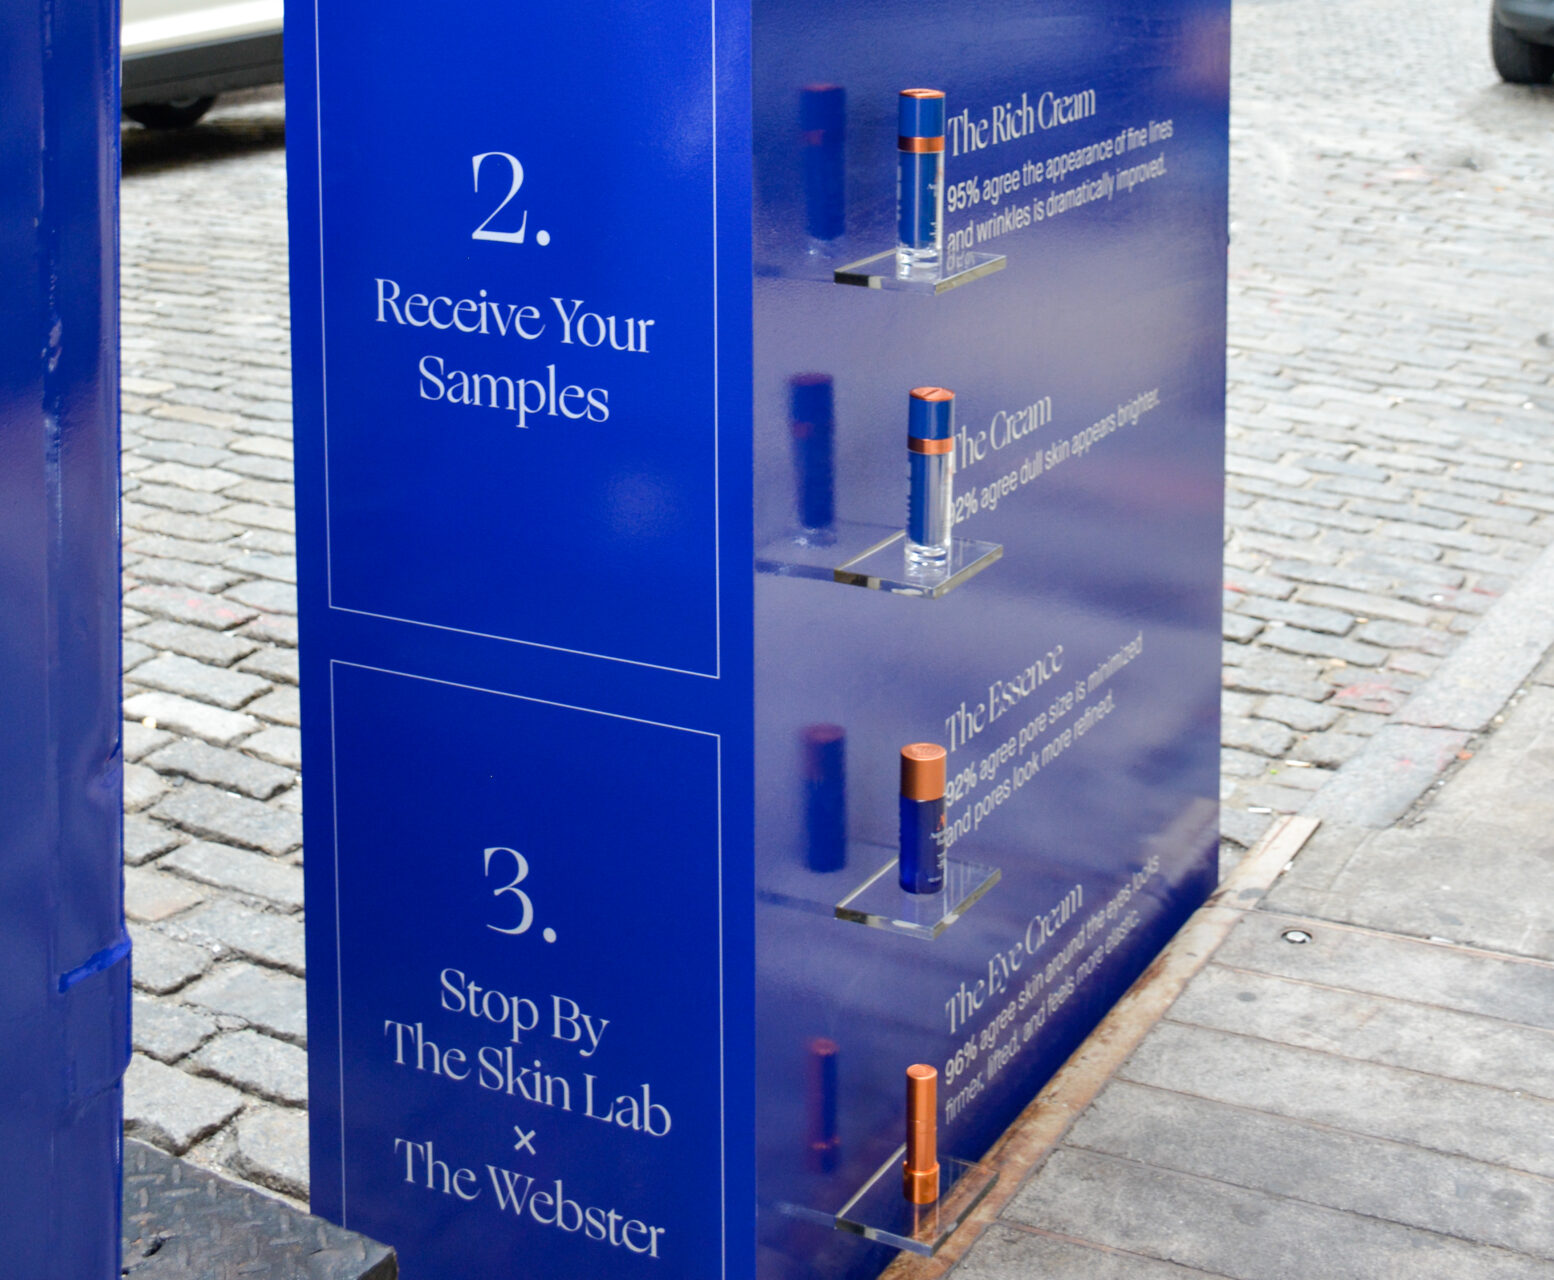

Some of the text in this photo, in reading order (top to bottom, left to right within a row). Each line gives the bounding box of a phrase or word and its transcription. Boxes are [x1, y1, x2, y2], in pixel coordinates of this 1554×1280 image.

[946, 175, 981, 213] 95%
[982, 173, 1021, 206] agree
[1022, 159, 1044, 187] the
[1045, 138, 1114, 184] appearance
[1114, 129, 1127, 156] of
[1126, 127, 1148, 151] fine
[1148, 119, 1174, 144] lines
[947, 88, 1097, 157] The Rich Cream
[471, 151, 551, 247] 2.
[947, 220, 974, 253] and
[976, 202, 1031, 243] wrinkles
[1032, 196, 1045, 224] is
[1045, 171, 1115, 218] dramatically
[374, 277, 655, 354] Receive Your
[418, 355, 610, 429] Samples
[989, 395, 1052, 451] Cream
[980, 470, 1018, 511] agree
[1019, 449, 1044, 486] dull
[1044, 439, 1071, 471] skin
[1071, 413, 1117, 458] appears
[945, 644, 1064, 753] The Essence
[945, 760, 978, 808] 92%
[979, 736, 1017, 781] agree
[1018, 712, 1047, 756] pore
[1048, 690, 1074, 725] size
[1074, 680, 1087, 704] is
[944, 803, 972, 849] and
[974, 778, 1012, 832] pores
[1012, 751, 1041, 792] look
[1041, 728, 1073, 768] more
[483, 846, 557, 944] 3.
[944, 884, 1083, 1035] The Eye Cream
[944, 1033, 978, 1085] 96%
[979, 1001, 1018, 1051] agree
[1018, 972, 1045, 1011] skin
[1044, 923, 1086, 983] around
[440, 968, 611, 1057] Stop By
[1022, 1000, 1046, 1043] and
[384, 1019, 672, 1137] The Skin Lab
[394, 1137, 666, 1260] The Webster
